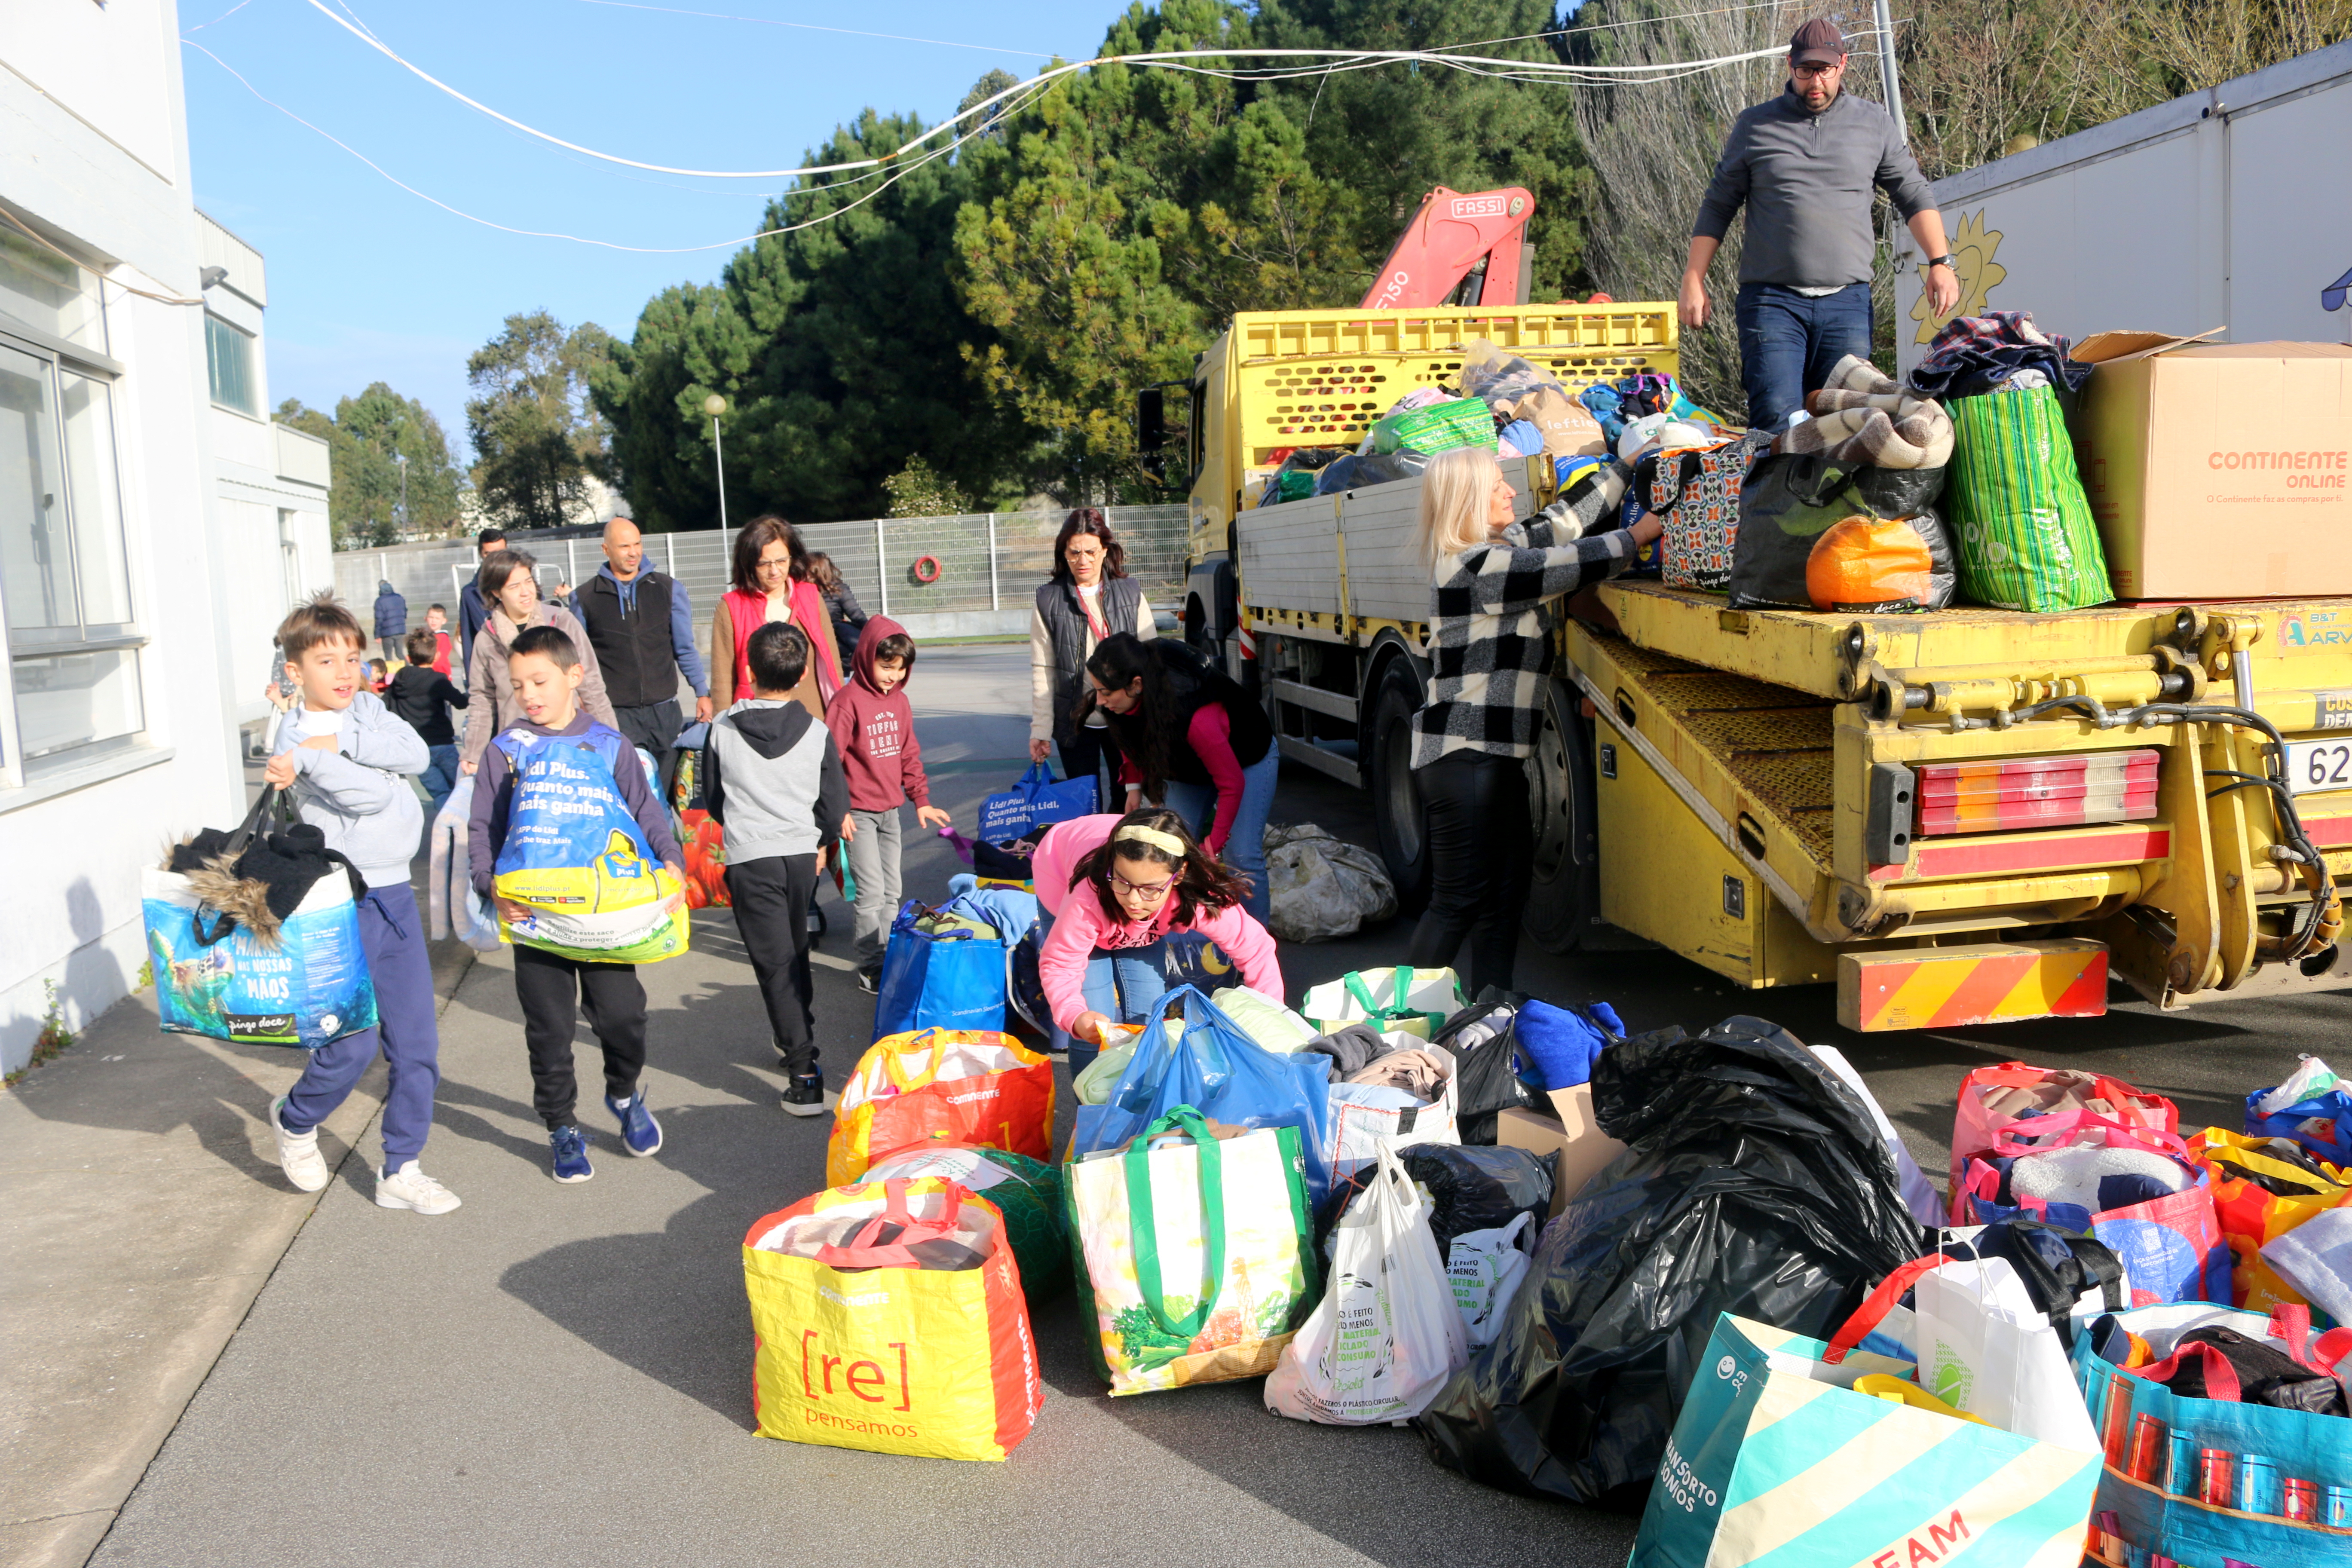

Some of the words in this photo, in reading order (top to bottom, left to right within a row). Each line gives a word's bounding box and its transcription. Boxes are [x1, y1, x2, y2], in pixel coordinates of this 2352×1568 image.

[1456, 199, 1501, 214] FASSI
[1547, 416, 1601, 429] lefties
[2208, 451, 2348, 470] CONTINENTE
[2286, 475, 2346, 488] ONLINE
[2216, 495, 2261, 503] Continente
[2263, 494, 2275, 503] faz
[2287, 496, 2319, 505] compras
[2321, 496, 2334, 504] por
[1874, 602, 1904, 614] doce
[2310, 612, 2337, 622] B&T
[550, 762, 590, 780] Plus.
[2309, 746, 2350, 784] 62
[520, 781, 574, 797] Quanto
[577, 787, 614, 803] mais
[551, 800, 605, 816] ganha
[987, 808, 1018, 819] Quanto
[1038, 801, 1060, 810] Lidl,
[989, 801, 1007, 810] Lidl
[1008, 798, 1025, 806] Plus
[986, 818, 1004, 828] mais
[544, 826, 559, 835] Lidl
[616, 868, 636, 877] plus
[237, 961, 250, 972] NAS
[252, 957, 292, 973] NOSSAS
[247, 973, 290, 1000] MÃOS
[952, 1008, 982, 1016] Scandinavian
[228, 1019, 257, 1034] pingo
[258, 1016, 286, 1028] doce
[946, 1088, 1000, 1105] CONTINENTE
[2150, 1250, 2172, 1259] DOWNLOAD
[1354, 1307, 1373, 1318] FEITO
[1349, 1318, 1373, 1329] MENOS
[1343, 1327, 1381, 1340] MATERIAL
[802, 1329, 910, 1412] [re]
[1297, 1388, 1313, 1403] JUNTOS
[1318, 1398, 1341, 1407] FAZEMOS
[1348, 1398, 1372, 1407] PLÁSTICO
[1373, 1395, 1400, 1406] CIRCULAR,
[806, 1408, 918, 1438] pensamos
